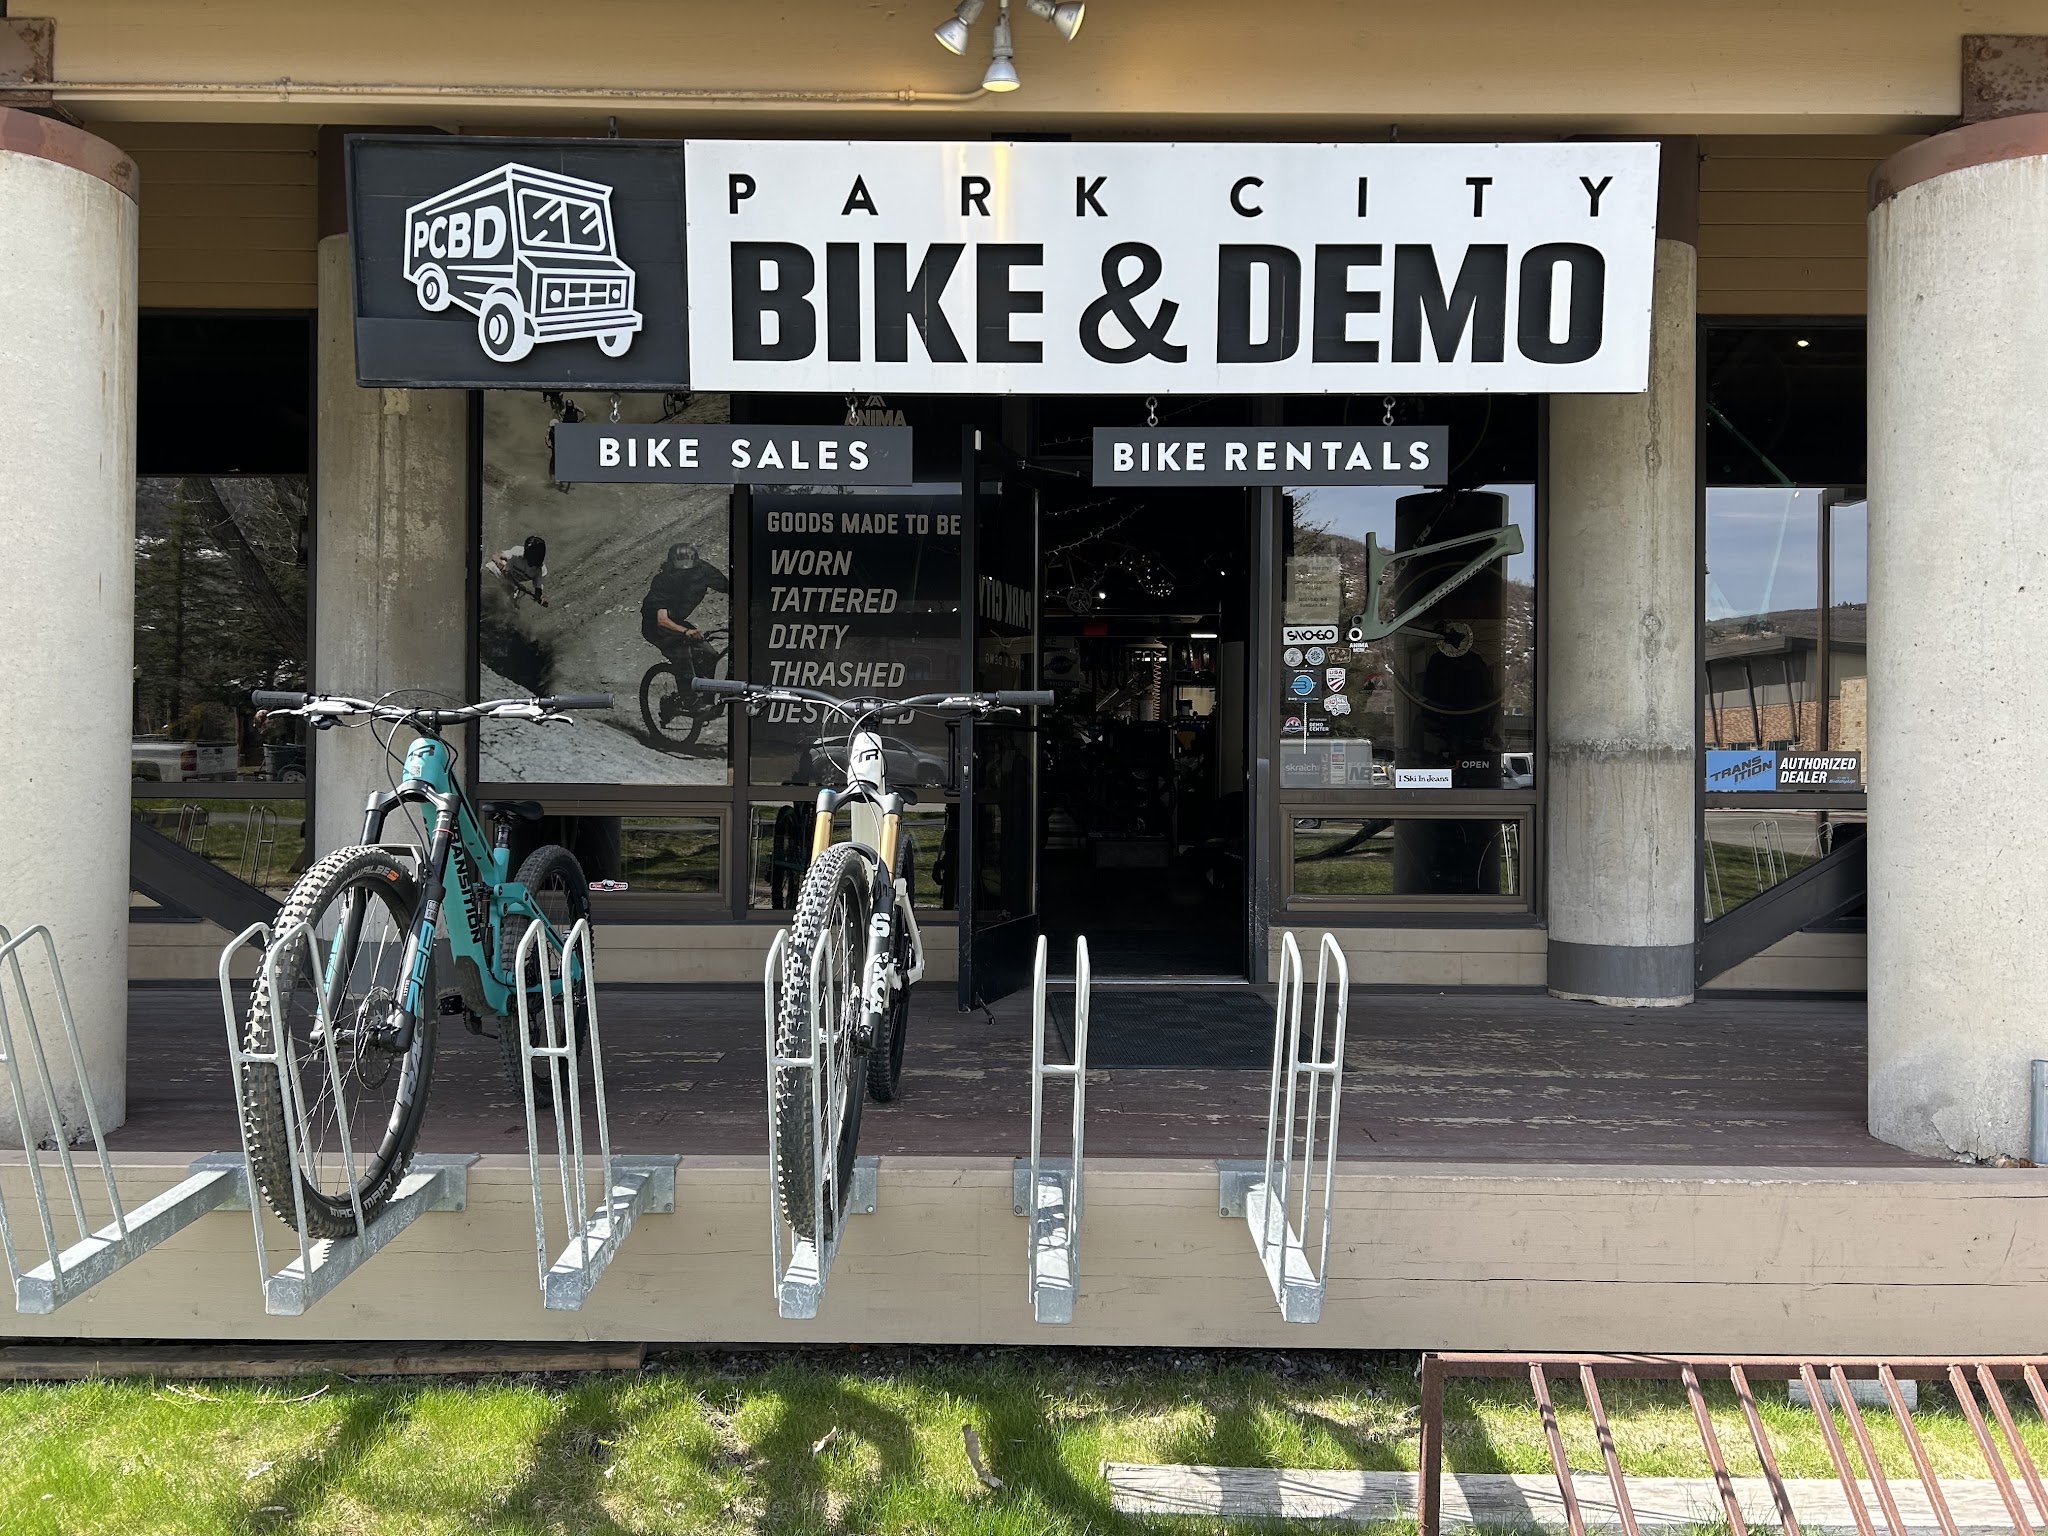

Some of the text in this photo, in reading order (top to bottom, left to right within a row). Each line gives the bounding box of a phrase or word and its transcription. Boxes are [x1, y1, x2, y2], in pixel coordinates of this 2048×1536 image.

[728, 172, 1613, 218] PARK CITY
[413, 205, 507, 259] PCBD
[730, 241, 1606, 363] BIKE & DEMO
[599, 437, 870, 471] BIKE SALES
[1112, 441, 1431, 472] BIKE RENTALS
[767, 511, 961, 535] GOODS MADE TO BE
[770, 550, 853, 576] WORN
[770, 587, 898, 614] TATTERED
[768, 623, 850, 650] DIRTY
[769, 661, 906, 688] THRASHED
[1461, 760, 1490, 769] OPEN
[1779, 757, 1857, 770] AUTHORIZED
[1403, 774, 1417, 782] Ski
[1426, 774, 1449, 782] Jeans
[1779, 771, 1828, 784] DEALER
[329, 1206, 356, 1218] MAG
